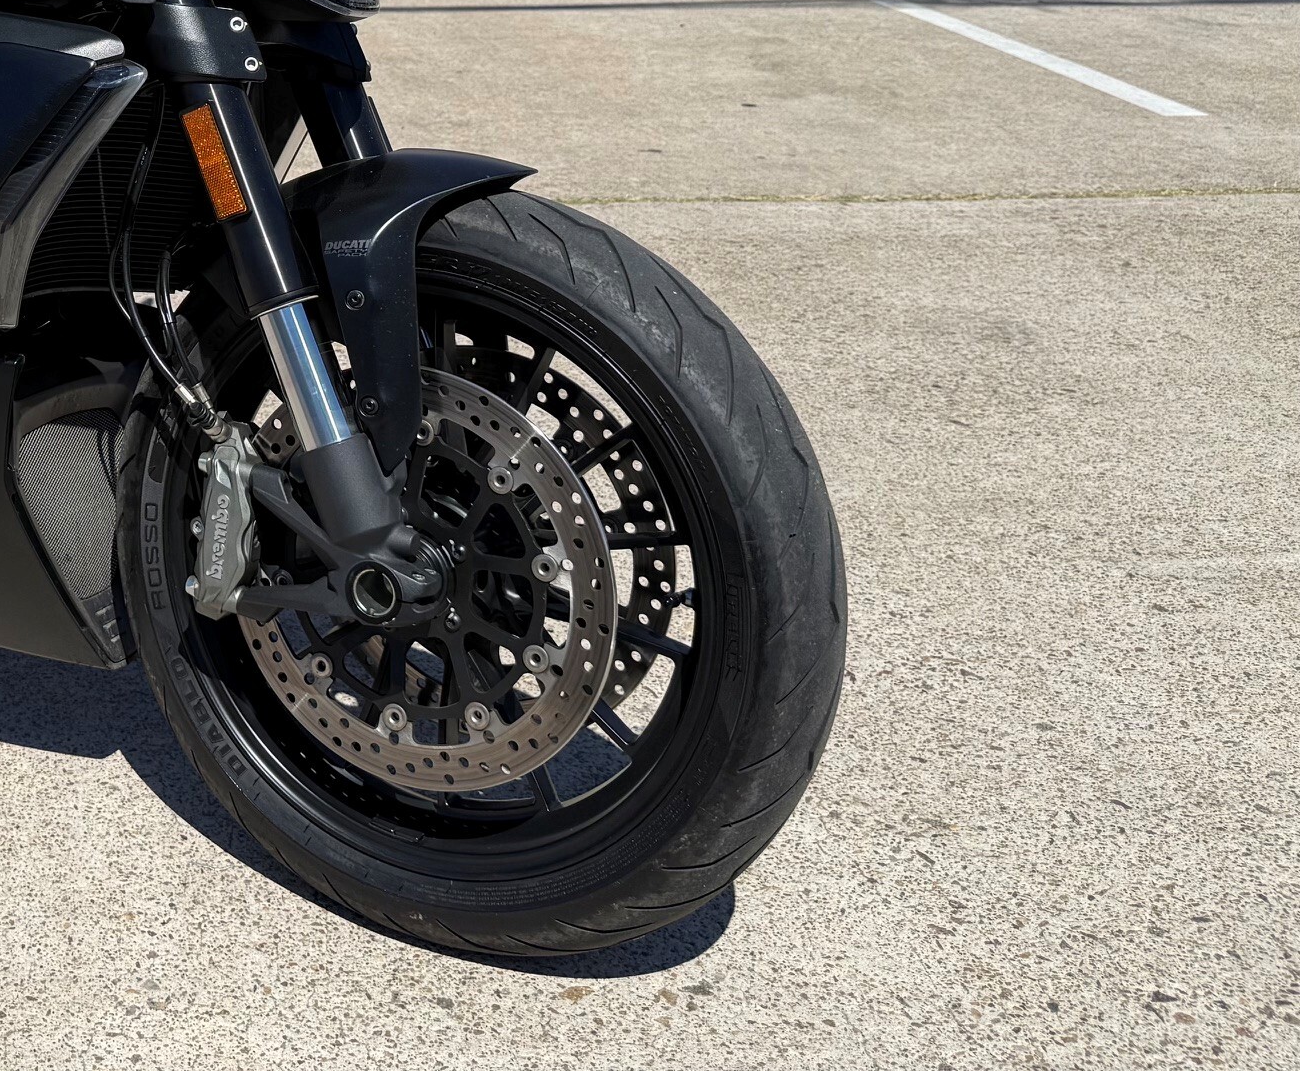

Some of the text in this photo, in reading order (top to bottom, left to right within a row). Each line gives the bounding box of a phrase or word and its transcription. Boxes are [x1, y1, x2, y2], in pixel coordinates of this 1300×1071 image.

[324, 238, 371, 250] DUCATI
[206, 493, 231, 580] brembo
[144, 502, 249, 778] DIABLO ROSSO
